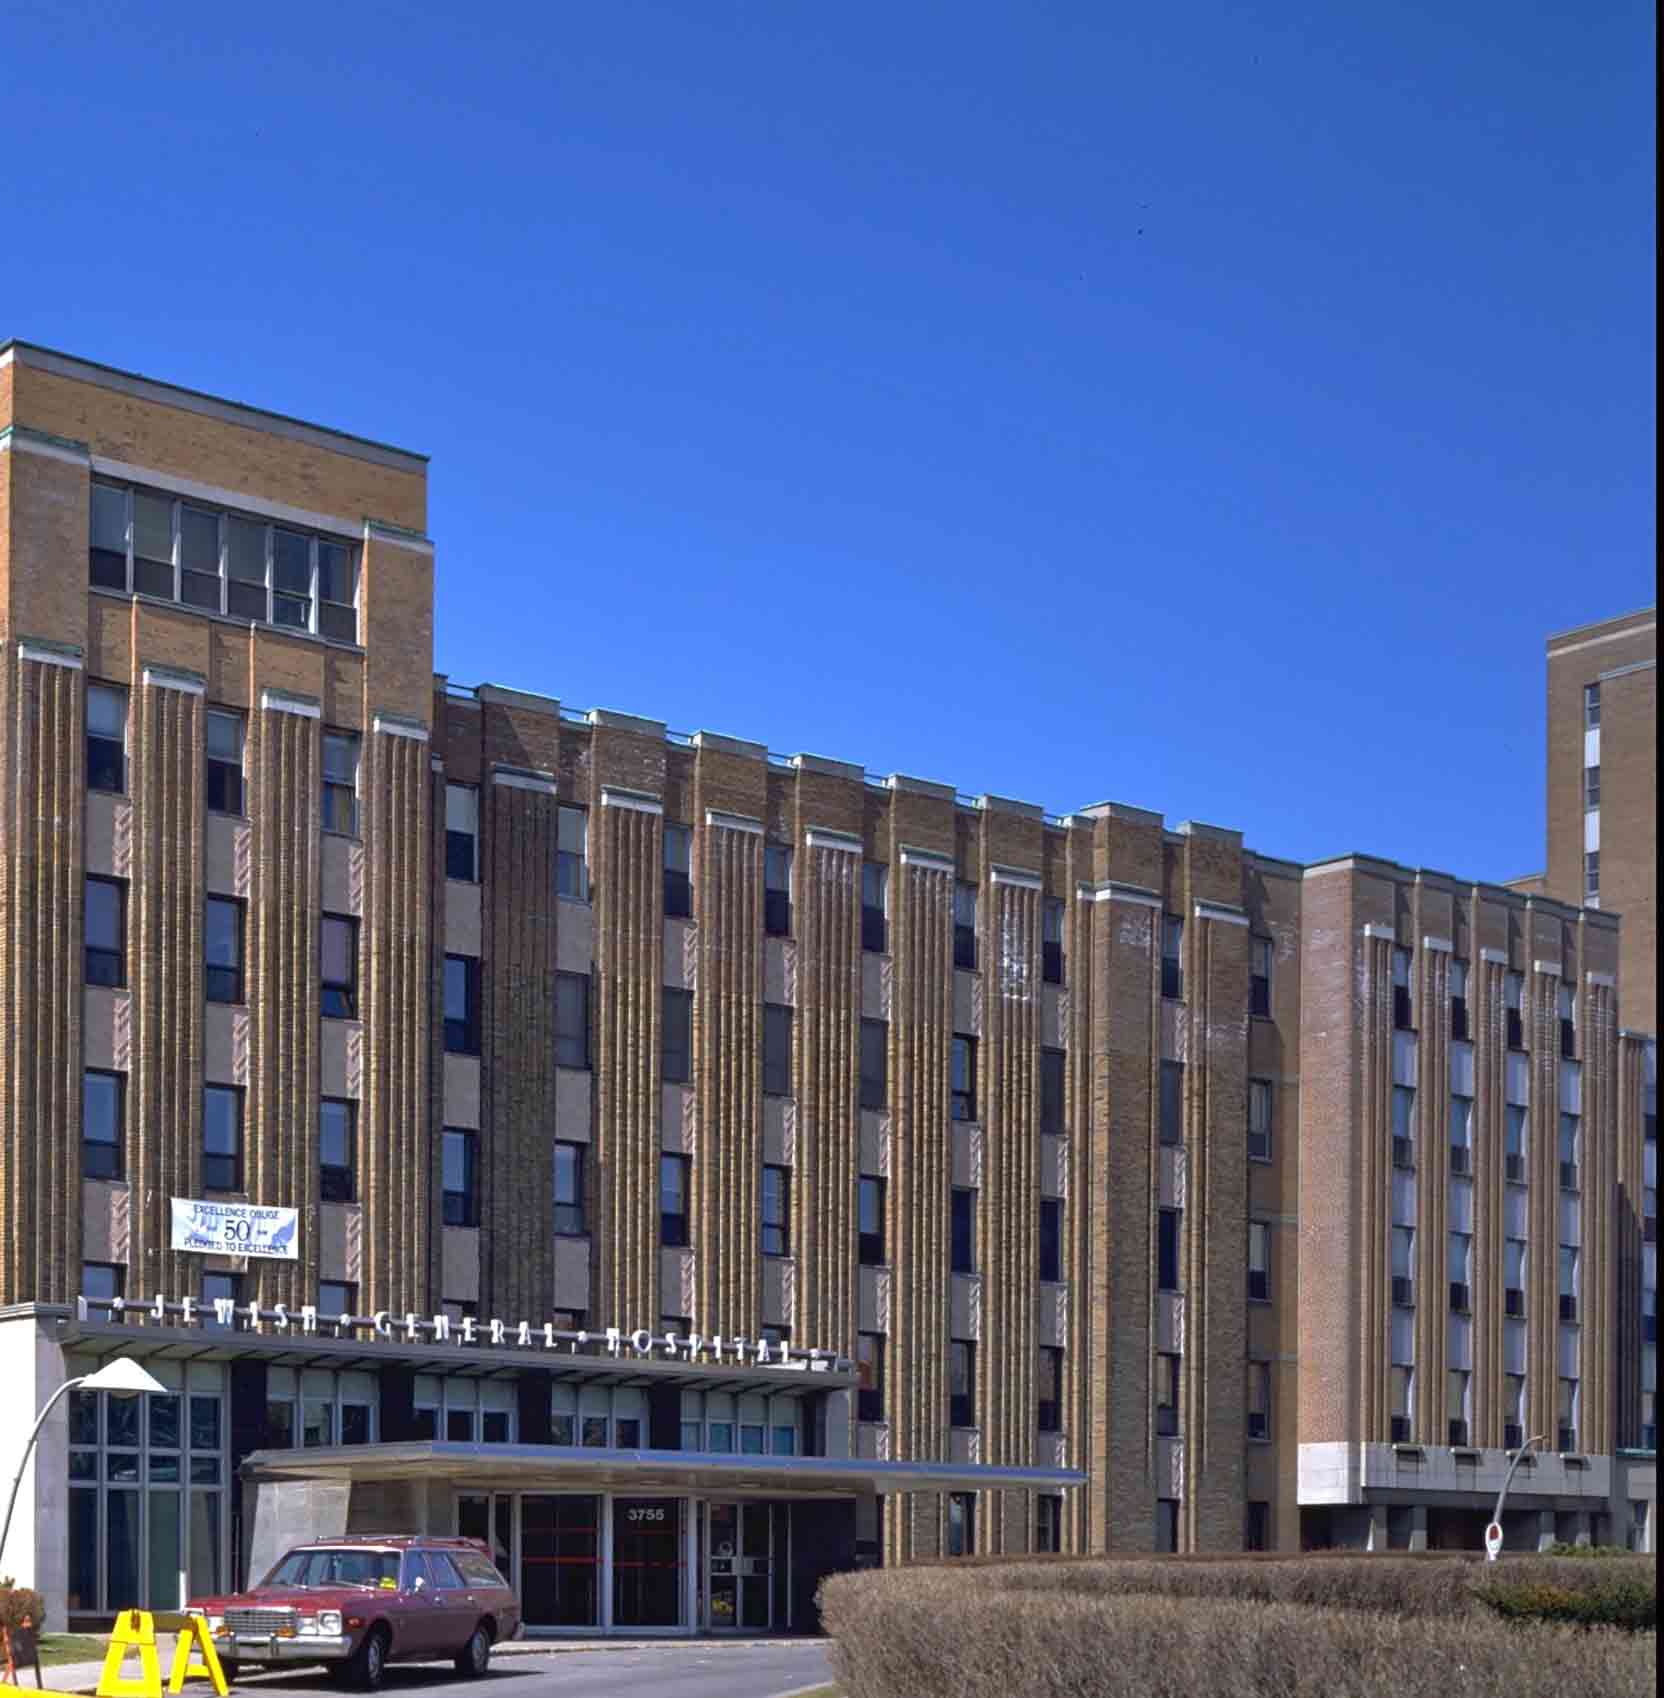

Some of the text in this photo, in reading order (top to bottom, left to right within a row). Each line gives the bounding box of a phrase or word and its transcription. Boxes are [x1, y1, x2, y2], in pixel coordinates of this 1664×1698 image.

[193, 1204, 247, 1218] EXCELLENCE
[224, 1220, 250, 1241] 50
[225, 1242, 236, 1253] TO
[150, 1294, 791, 1362] JEWISH GENERAL HOSPITAL
[627, 1508, 664, 1521] 3755
